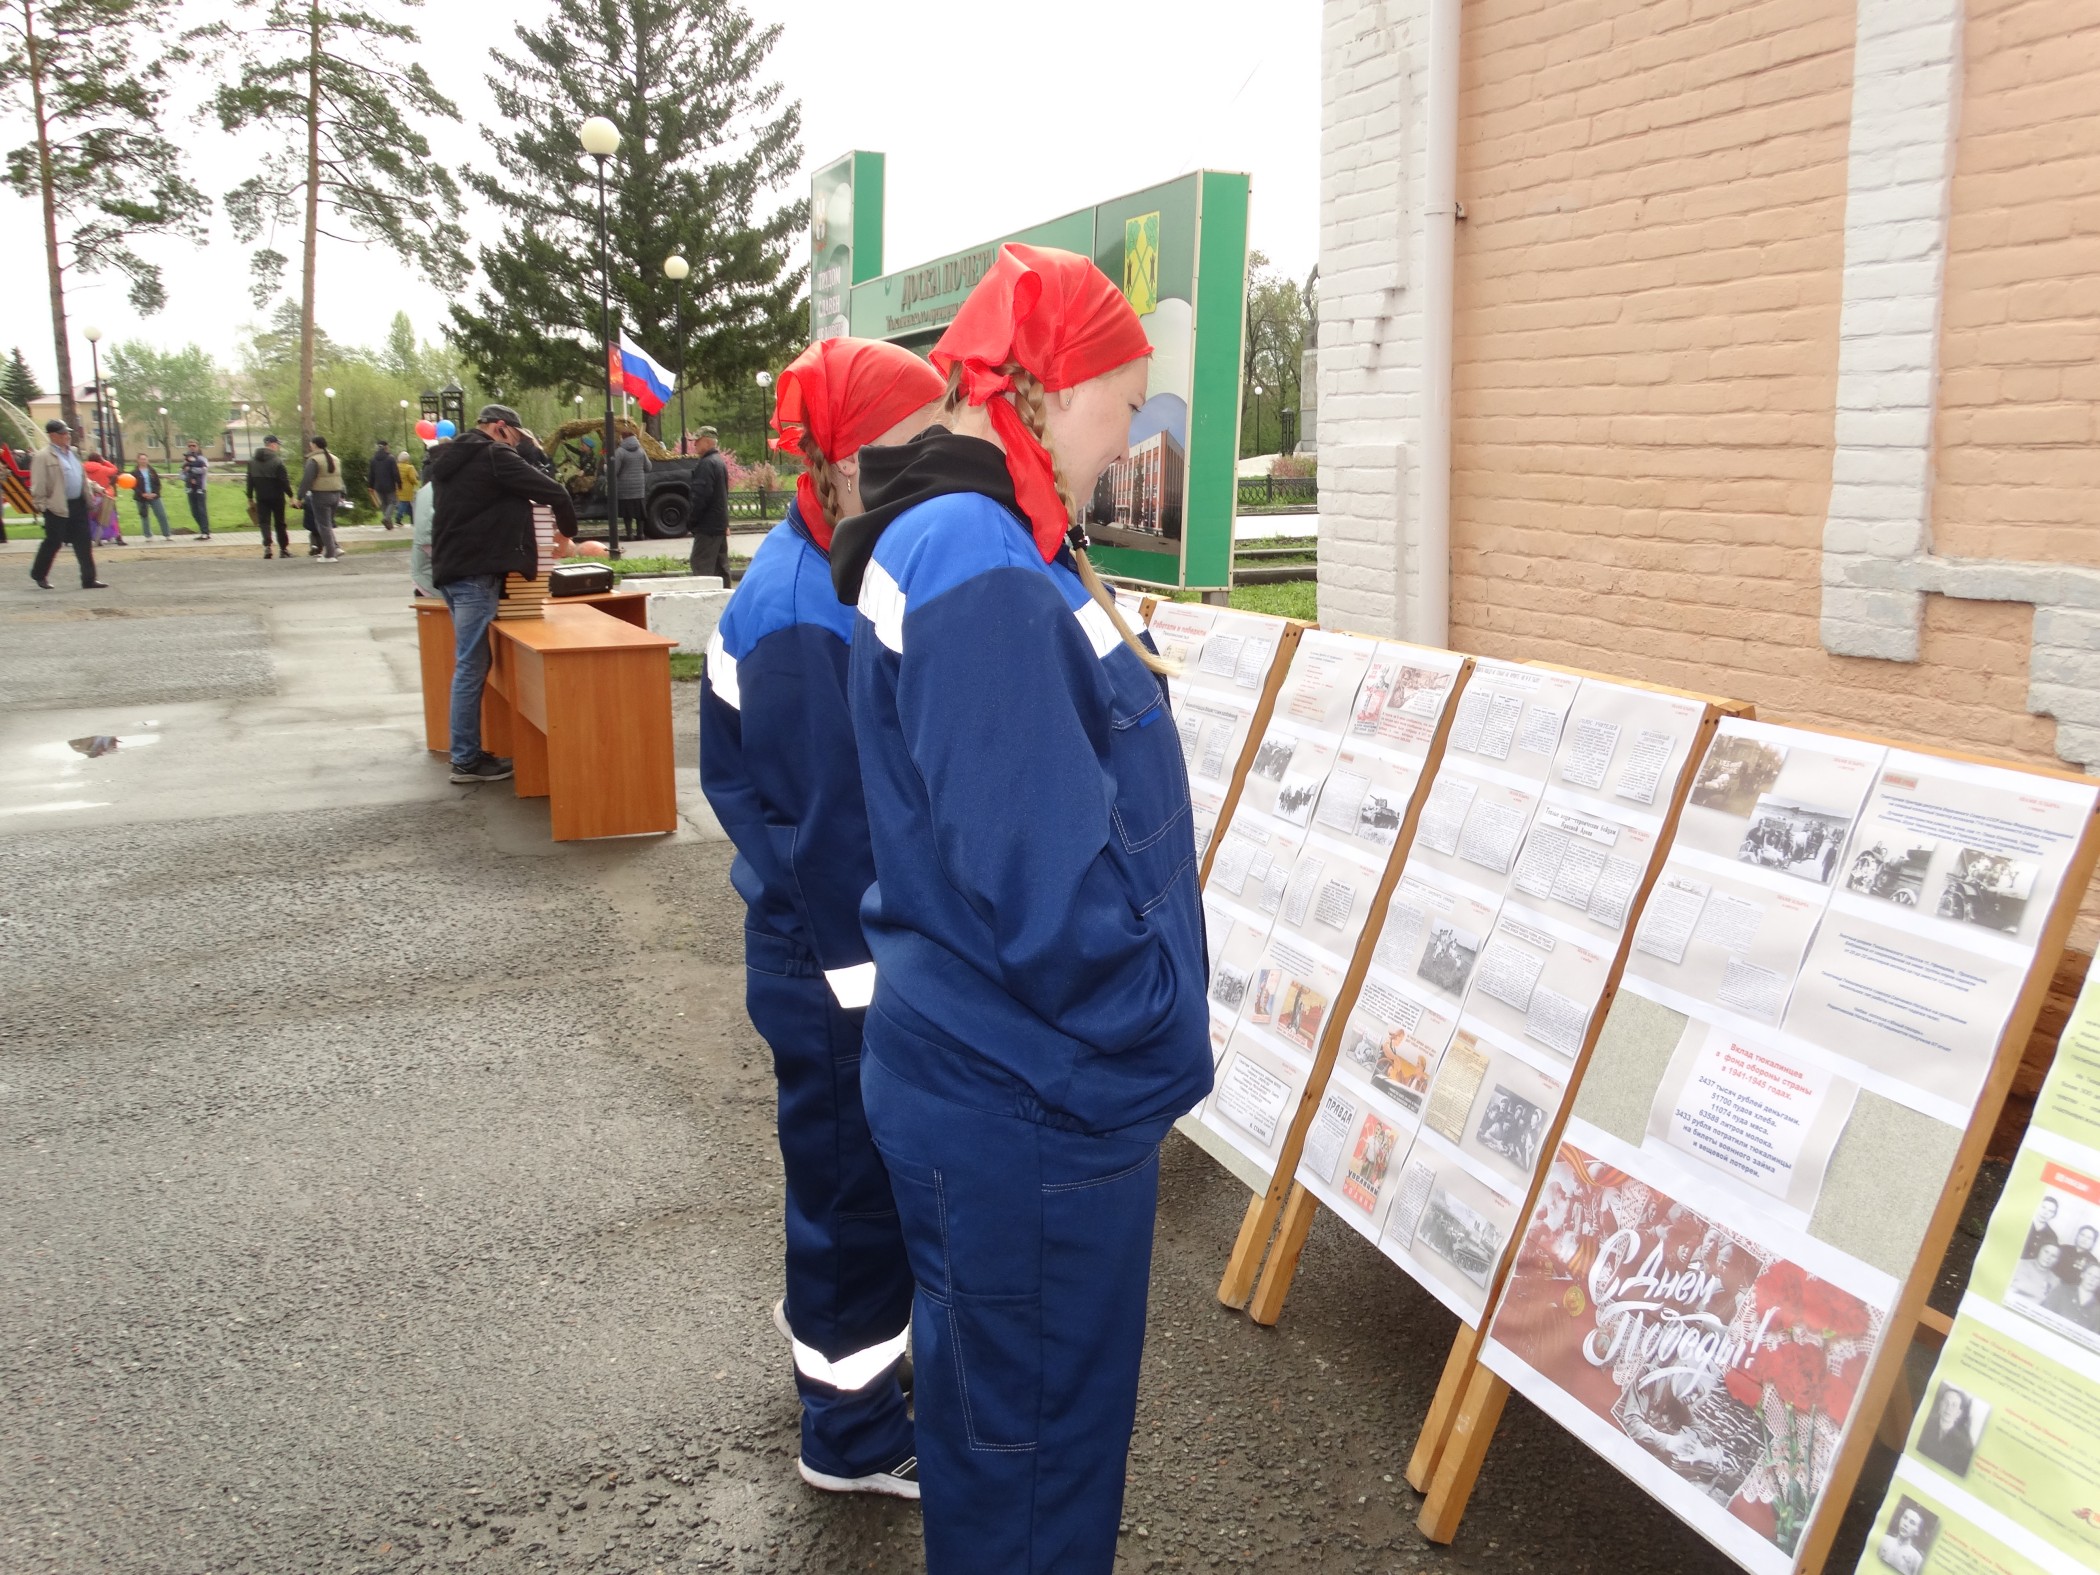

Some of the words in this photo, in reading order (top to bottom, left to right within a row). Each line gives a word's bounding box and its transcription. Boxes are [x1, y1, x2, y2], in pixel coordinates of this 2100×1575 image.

[818, 267, 841, 291] ТРУДОМ
[902, 267, 940, 311] ДОСКА
[818, 296, 840, 317] СЛАВЕН
[1724, 1053, 1745, 1068] фонд
[1746, 1063, 1781, 1083] обороны
[1782, 1078, 1813, 1096] страны
[1730, 1043, 1753, 1060] Вклад
[1755, 1055, 1804, 1079] тюкалинцев
[1698, 1075, 1716, 1088] 2437
[1715, 1083, 1736, 1097] тысяч
[1737, 1094, 1762, 1109] рублей
[1763, 1104, 1801, 1126] деньгами.
[1728, 1067, 1767, 1088] 1941-1945
[1767, 1084, 1792, 1100] годах.
[1326, 1097, 1353, 1124] ПРАВДА
[1711, 1092, 1732, 1107] 51700
[1732, 1103, 1753, 1117] пудов
[1754, 1112, 1777, 1127] хлеба.
[1711, 1103, 1731, 1117] 11074
[1732, 1114, 1748, 1127] пуда
[1750, 1121, 1769, 1135] мяса.
[1674, 1108, 1692, 1121] 3433
[1691, 1117, 1712, 1131] рубля
[1712, 1127, 1752, 1149] потратили
[1750, 1144, 1792, 1170] тюкалинцы
[1698, 1109, 1719, 1123] 63588
[1720, 1120, 1744, 1136] литров
[1745, 1131, 1774, 1150] молока.
[1683, 1124, 1692, 1133] на
[1692, 1128, 1718, 1145] билеты
[1718, 1141, 1751, 1162] военного
[1752, 1157, 1776, 1174] займа
[1698, 1144, 1729, 1163] вещевой
[1729, 1158, 1760, 1178] лотереи.
[1583, 1300, 1781, 1398] Победы!
